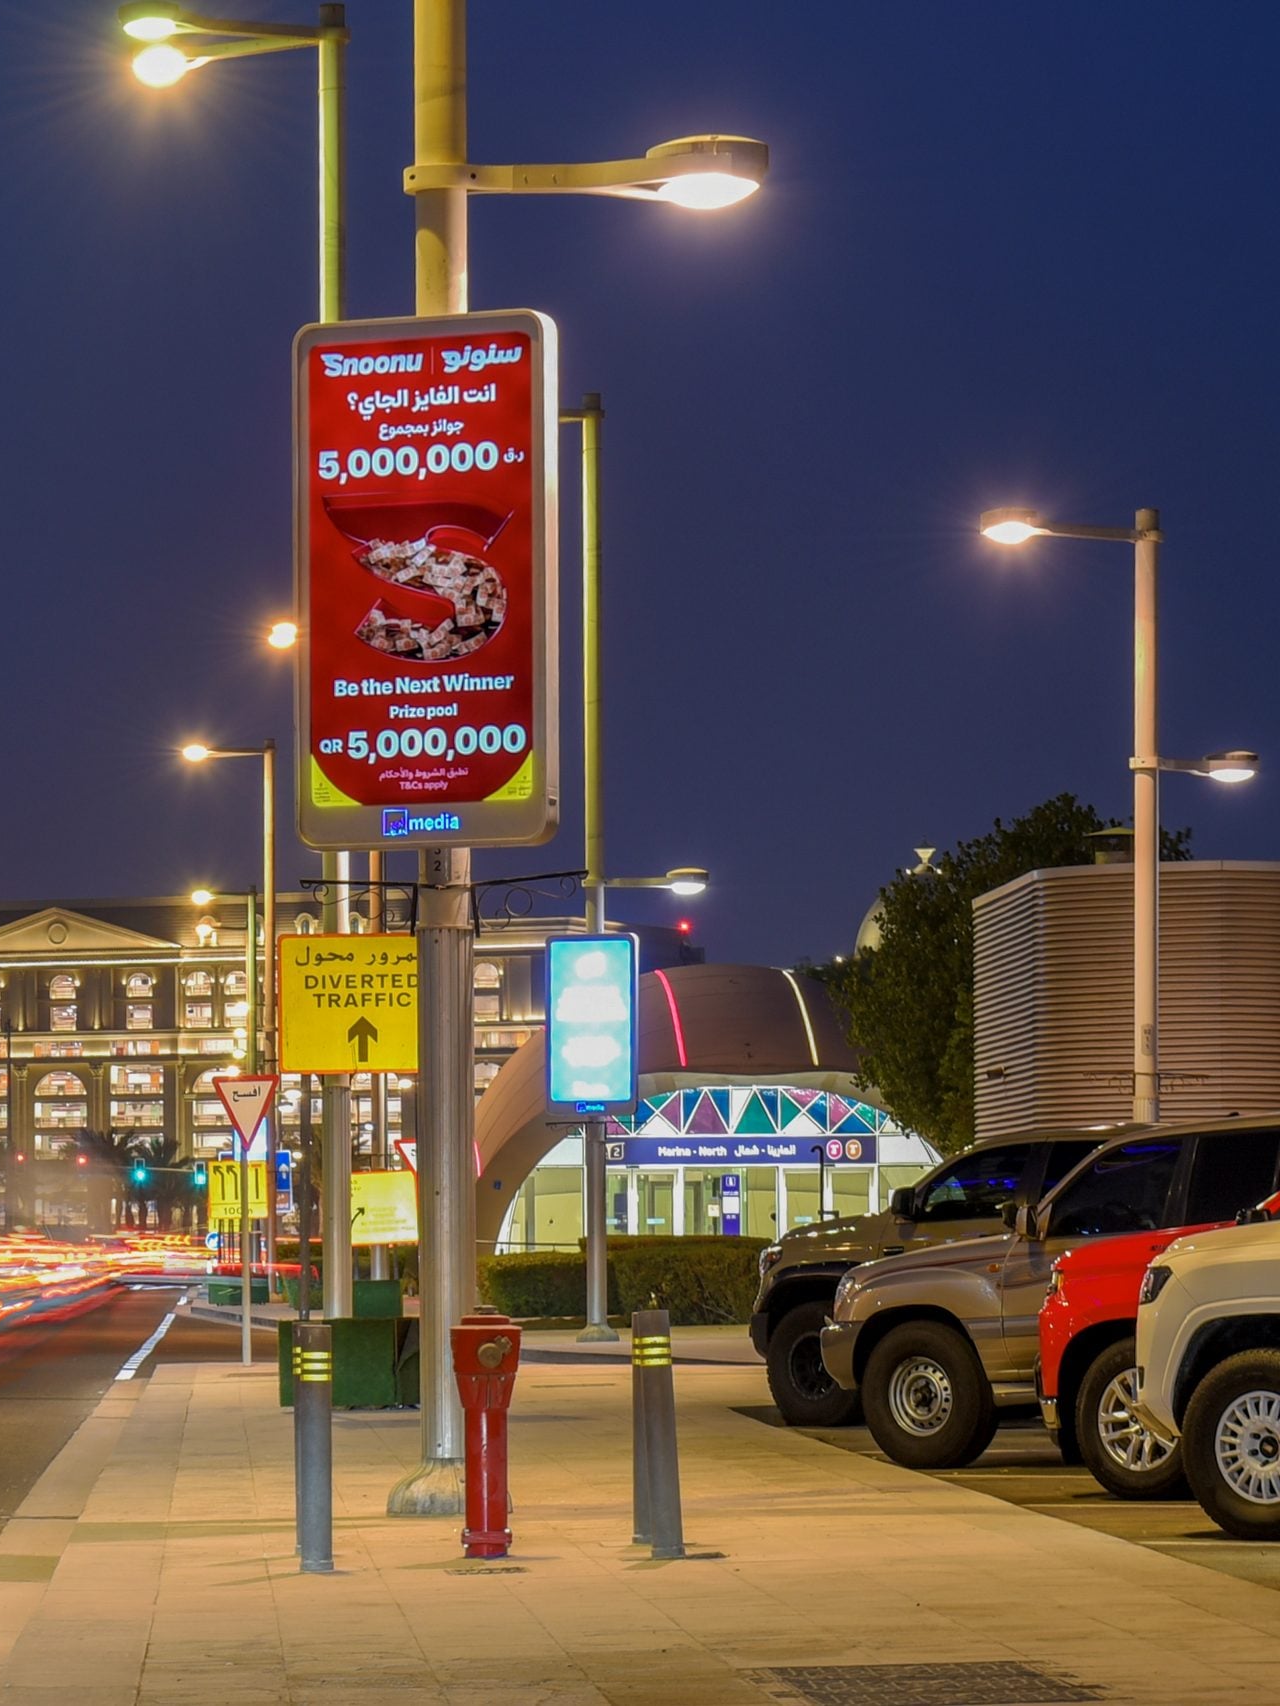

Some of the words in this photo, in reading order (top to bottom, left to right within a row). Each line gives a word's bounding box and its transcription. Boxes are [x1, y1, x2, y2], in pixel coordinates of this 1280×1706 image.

[320, 353, 423, 377] Snoonu
[441, 343, 522, 373] سنونو
[411, 386, 459, 412] الفايز
[463, 383, 496, 402] انت
[378, 423, 429, 441] بمجموع
[431, 419, 464, 436] جوائز
[318, 441, 499, 485] 5,000,000
[334, 679, 358, 697] Be
[361, 678, 393, 695] the
[395, 676, 441, 693] Next
[442, 673, 514, 692] Winner
[389, 705, 425, 719] Prize
[426, 703, 458, 719] pool
[320, 738, 343, 754] QR
[347, 724, 526, 764] 5,000,000
[400, 781, 423, 790] T&Cs
[424, 781, 448, 791] apply
[409, 813, 459, 831] media
[295, 945, 354, 966] محول
[365, 952, 418, 966] مرور
[304, 974, 419, 990] DIVERTED
[312, 992, 412, 1008] TRAFFIC
[657, 1145, 691, 1157] Marina
[698, 1145, 727, 1157] North
